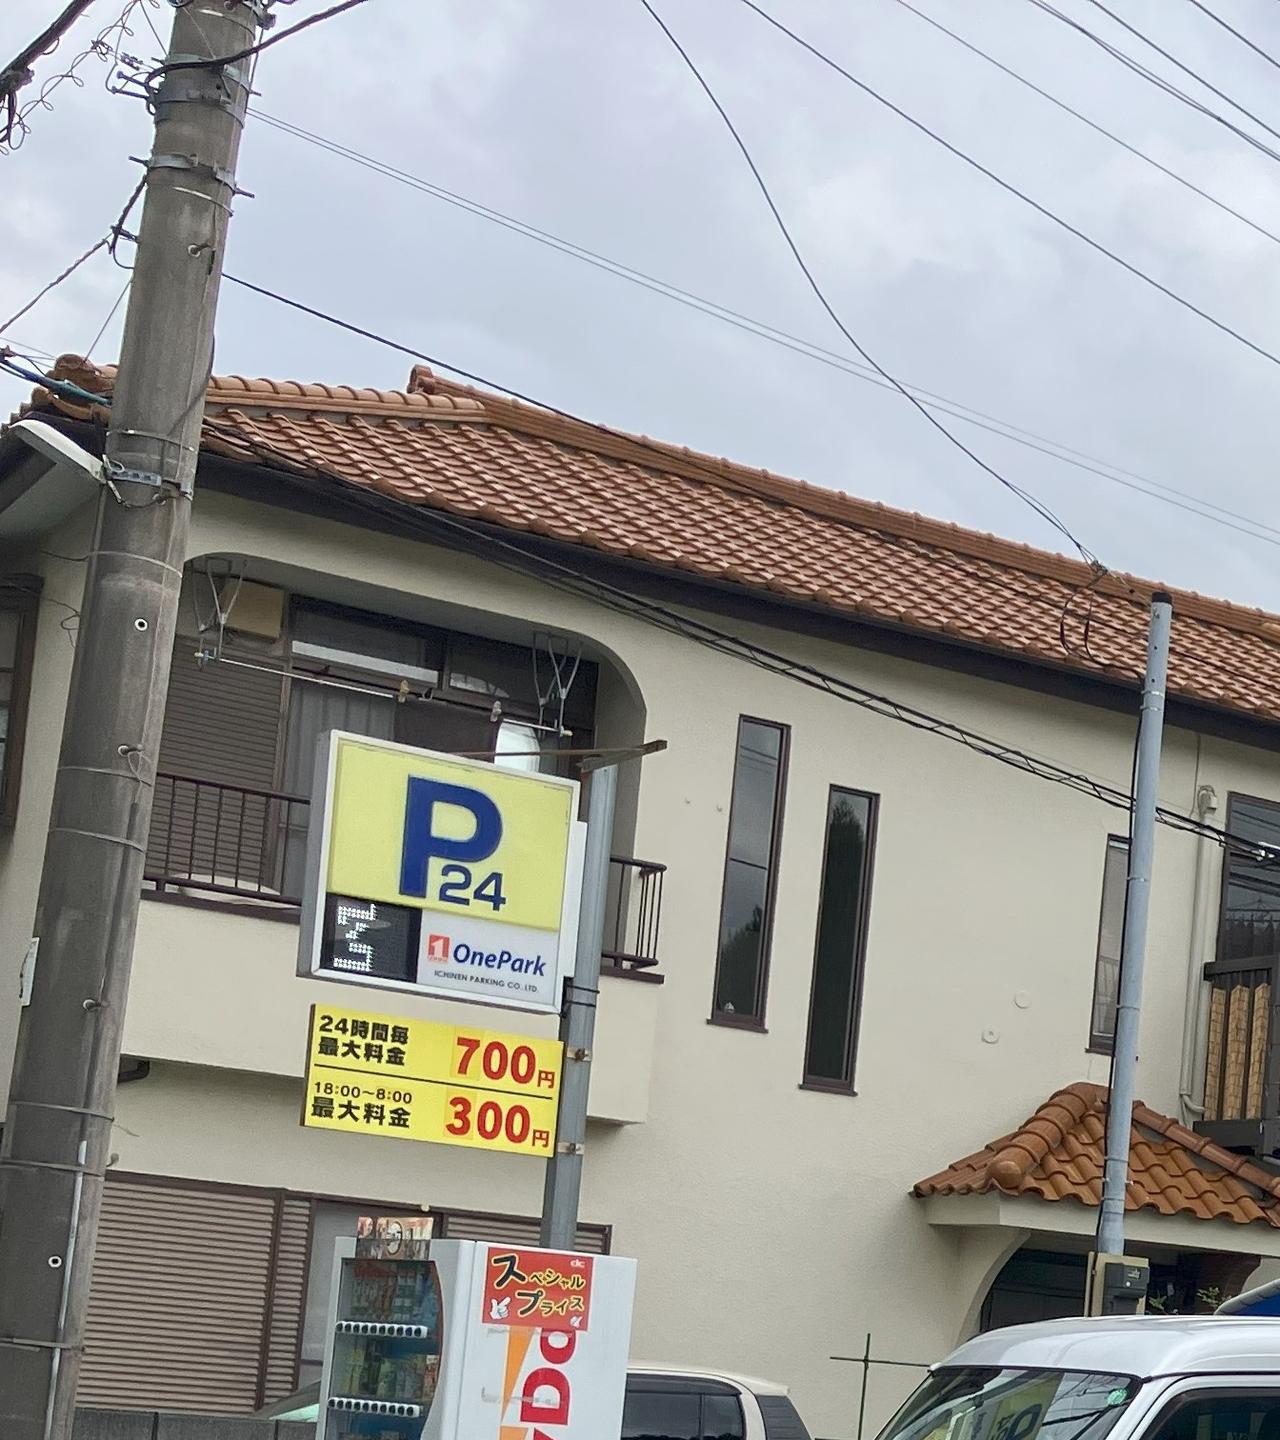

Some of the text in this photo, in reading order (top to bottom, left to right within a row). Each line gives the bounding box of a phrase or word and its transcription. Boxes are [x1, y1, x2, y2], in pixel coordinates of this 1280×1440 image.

[400, 774, 503, 898] P
[439, 865, 507, 912] 24
[453, 943, 546, 976] OnePark
[469, 975, 505, 987] PARKING
[319, 1015, 409, 1045] 24時間毎
[318, 1036, 406, 1066] 最大料金
[457, 1037, 555, 1088] 700円
[311, 1096, 411, 1128] 最大料金
[446, 1096, 550, 1148] 300円
[493, 1254, 585, 1289] スペシャル
[516, 1289, 584, 1316] プライス
